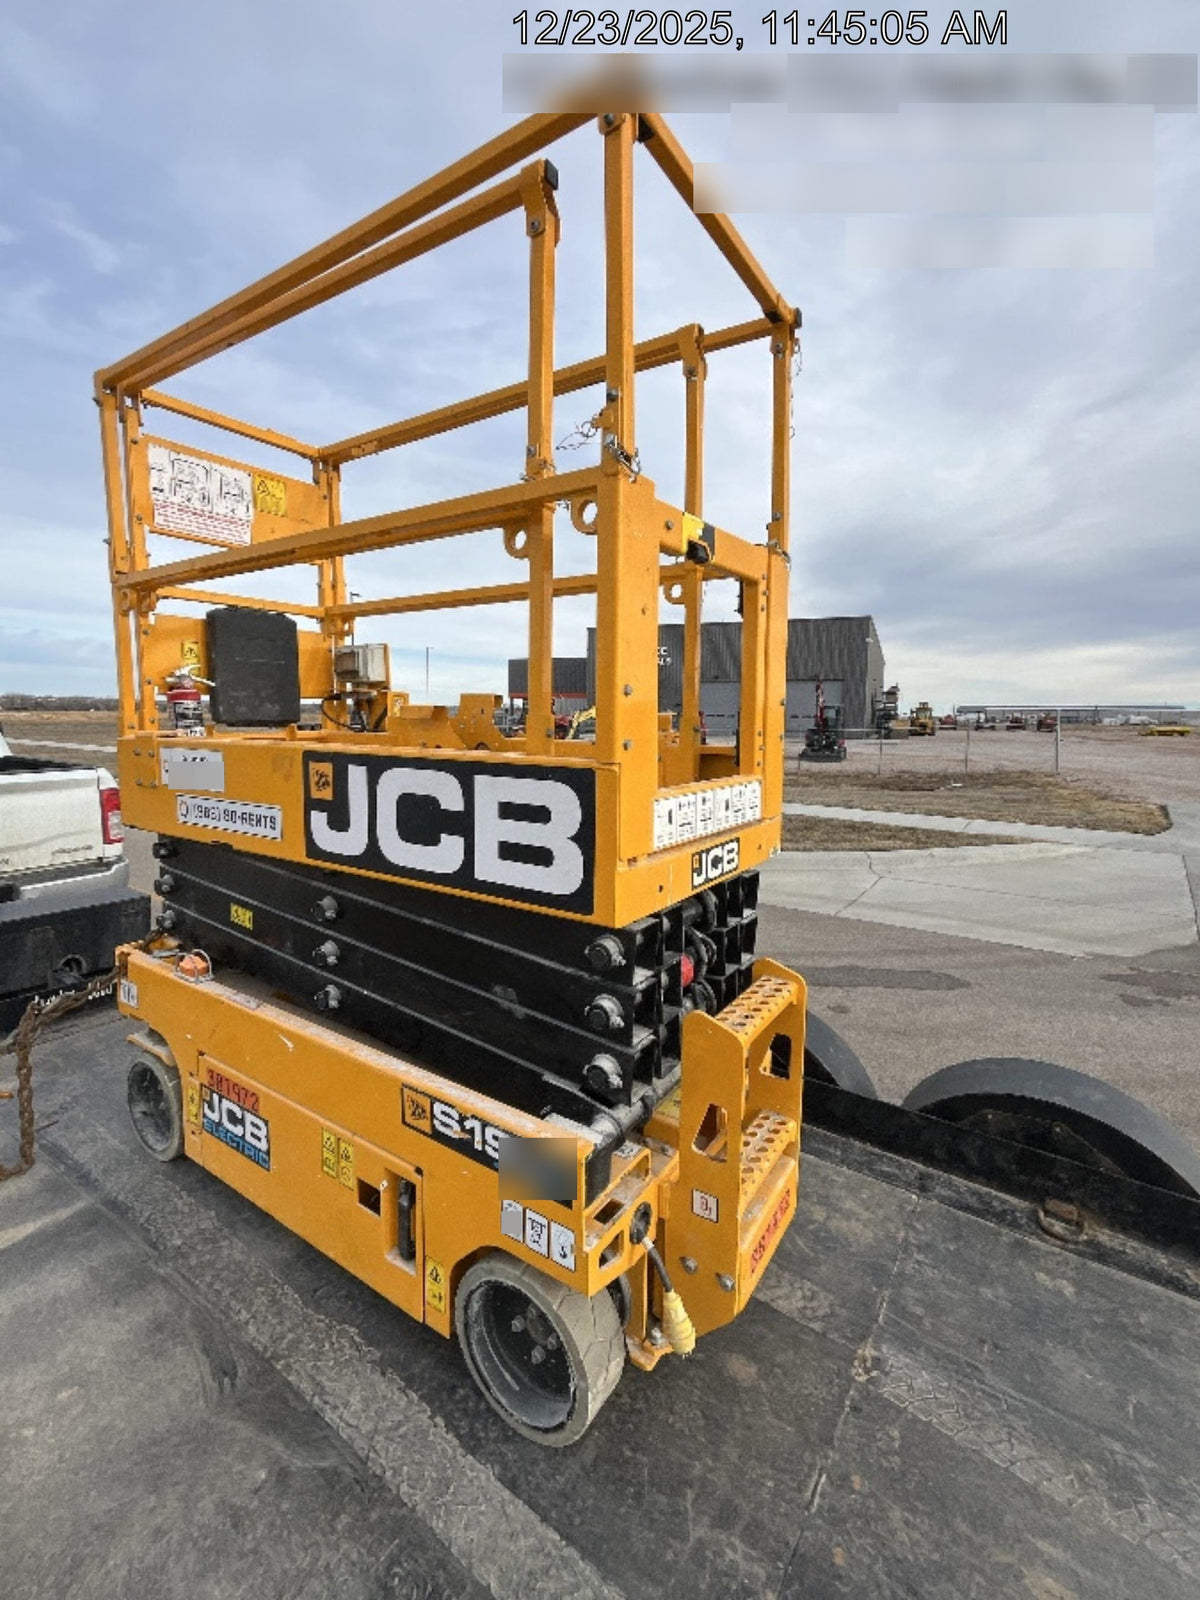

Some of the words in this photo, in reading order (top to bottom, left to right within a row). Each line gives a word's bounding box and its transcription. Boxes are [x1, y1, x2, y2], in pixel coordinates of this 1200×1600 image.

[310, 763, 584, 896] JCB
[693, 839, 739, 887] JCB
[204, 1092, 268, 1152] JCB
[204, 1117, 270, 1170] ELECTRIC
